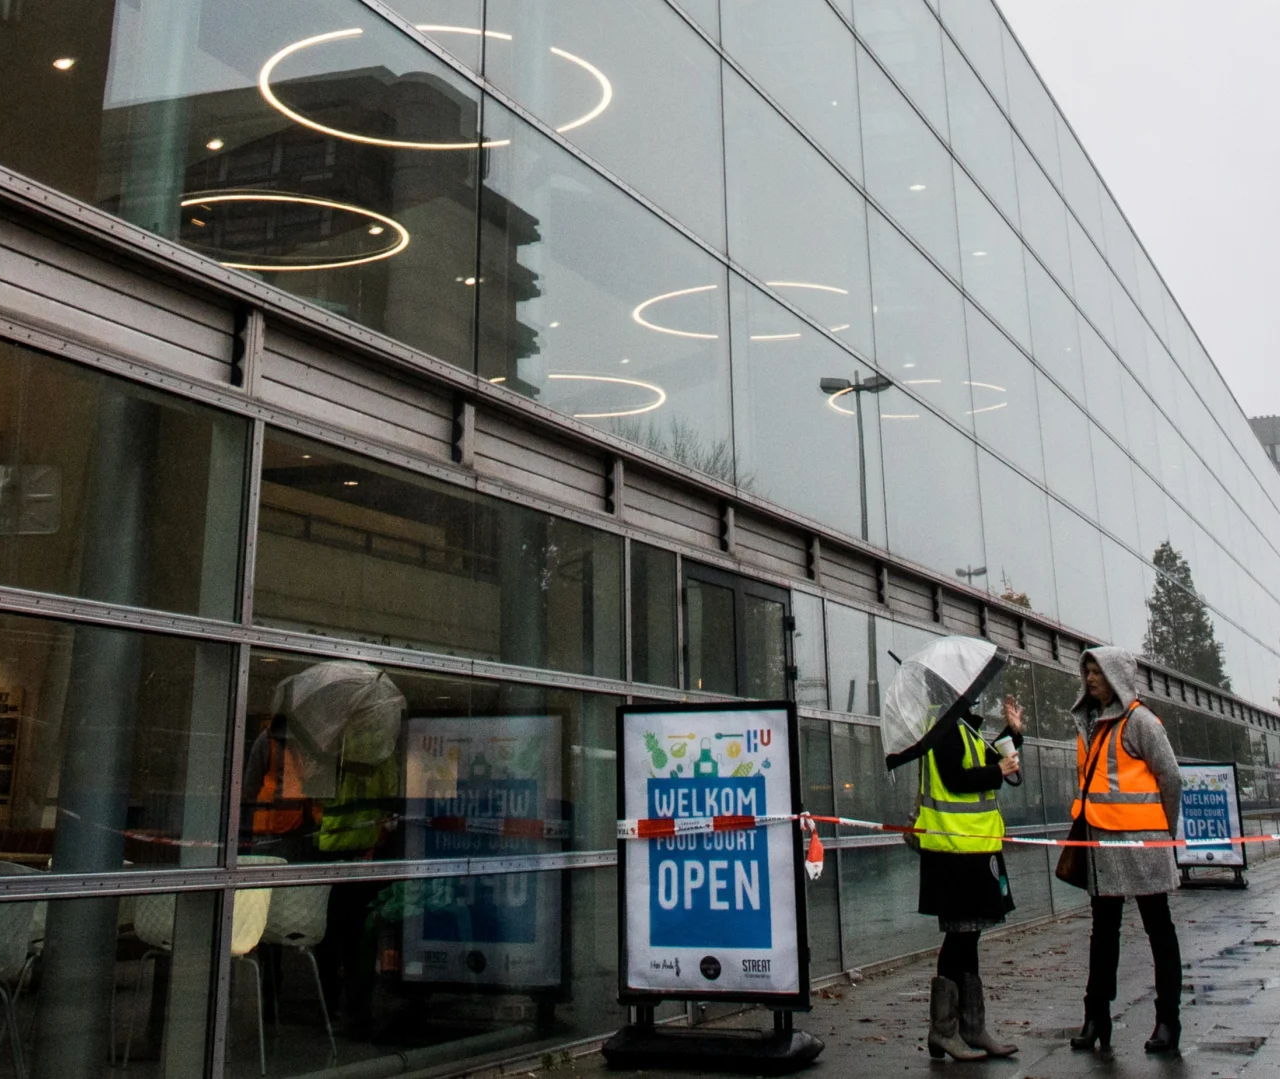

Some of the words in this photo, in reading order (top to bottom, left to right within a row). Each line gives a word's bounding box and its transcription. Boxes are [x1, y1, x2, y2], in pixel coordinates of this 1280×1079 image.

[746, 729, 772, 753] HU
[654, 787, 757, 817] WELKOM
[1183, 793, 1224, 805] WELKOM
[1185, 808, 1202, 817] FOOD
[1187, 818, 1228, 838] OPEN
[656, 831, 697, 851] FOOD
[703, 829, 758, 851] COURT
[658, 859, 761, 910] OPEN
[742, 959, 771, 972] STREAT
